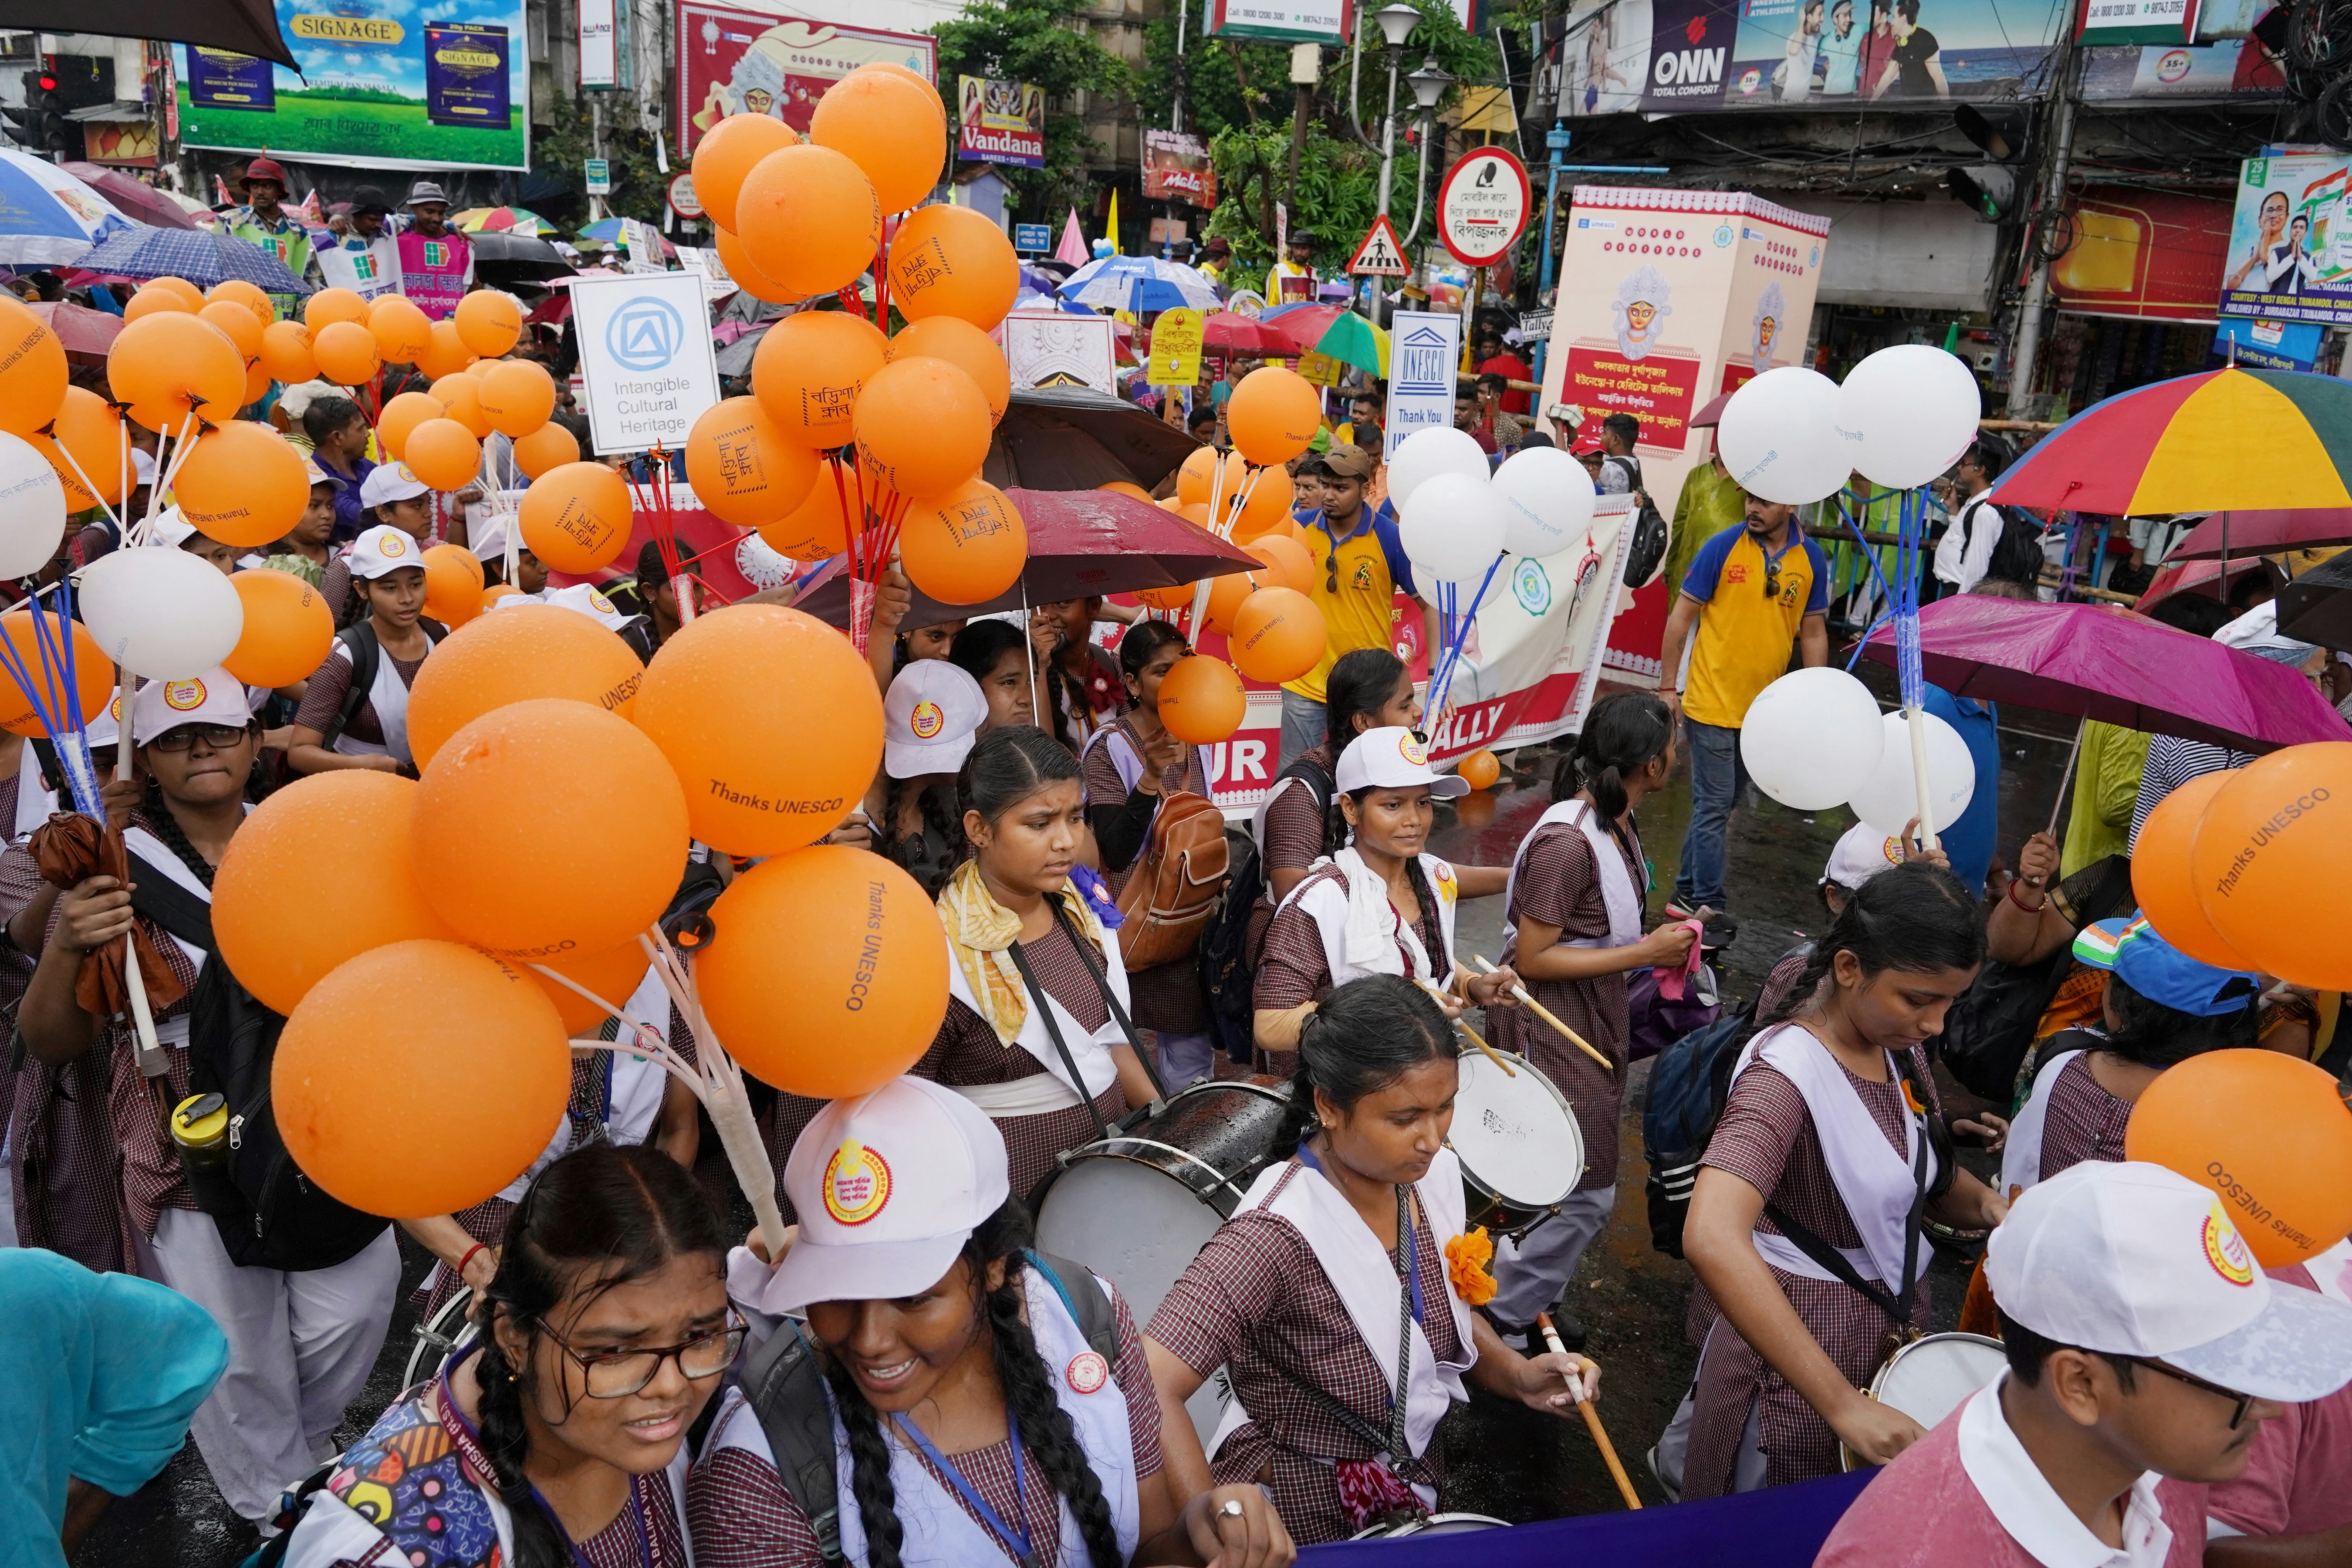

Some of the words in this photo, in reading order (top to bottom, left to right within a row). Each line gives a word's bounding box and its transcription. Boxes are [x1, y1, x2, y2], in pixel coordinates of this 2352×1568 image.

[1243, 9, 1256, 18] 1800
[1257, 10, 1271, 19] 1200
[1750, 6, 1796, 17] ATHLEISURE
[2100, 4, 2112, 17] 1800
[2112, 4, 2125, 16] 1200
[2126, 3, 2136, 15] 300
[302, 18, 392, 40] SIGNAGE
[442, 52, 493, 66] SIGNAGE
[1655, 47, 1726, 85] ONN
[1538, 64, 1561, 95] ON
[1652, 87, 1676, 97] TOTAL
[1677, 84, 1720, 96] COMFORT
[964, 126, 1042, 156] Vandana
[981, 153, 1006, 162] SAREES
[2251, 162, 2264, 173] 29
[1162, 173, 1201, 191] Mala
[1490, 193, 1508, 203] কানে
[1483, 208, 1496, 218] পার
[1625, 227, 1685, 240] WORLD
[909, 239, 929, 257] BARISHA
[1604, 241, 1701, 258] HERITAGE
[895, 256, 908, 267] CLUB
[1109, 265, 1147, 273] JioMart
[2323, 282, 2352, 293] MAMAT
[2230, 292, 2257, 303] COURTESY
[2261, 294, 2275, 304] WEST
[2276, 296, 2297, 306] BENGAL
[2299, 297, 2333, 308] TRINAMOOL
[2225, 303, 2250, 314] PUBLISHED
[2251, 305, 2260, 315] BY
[2264, 306, 2300, 318] BURRABAZAR
[2301, 308, 2334, 321] TRINAMOOL
[0, 351, 22, 373] hanks
[20, 325, 46, 353] UNESCO
[1403, 349, 1444, 381] UNESCO
[615, 377, 689, 395] Intangible
[618, 397, 677, 414] Cultural
[1399, 408, 1425, 423] Thank
[1426, 409, 1442, 423] You
[620, 418, 686, 433] Heritage
[1284, 432, 1304, 441] Thanks
[750, 436, 759, 456] CLUB
[754, 456, 767, 481] BARISHA
[74, 485, 96, 501] Thanks
[965, 495, 990, 507] BARISHA
[581, 503, 593, 515] CLUB
[949, 500, 966, 511] CLUB
[184, 510, 216, 522] UNESCO
[216, 507, 251, 521] Thanks
[592, 514, 612, 530] BARISHA
[1264, 615, 1285, 631] Thanks
[1245, 629, 1266, 650] UNESCO
[1427, 702, 1506, 754] ALLY
[709, 778, 770, 811] Thanks
[775, 797, 842, 814] UNESCO
[2217, 847, 2256, 898] Thanks
[2251, 787, 2330, 848] UNESCO
[868, 881, 886, 929] Thanks
[846, 935, 883, 1012] UNESCO
[2206, 1161, 2272, 1223] UNESCO
[2271, 1219, 2317, 1251] Thanks
[643, 1506, 661, 1559] BALIKA
